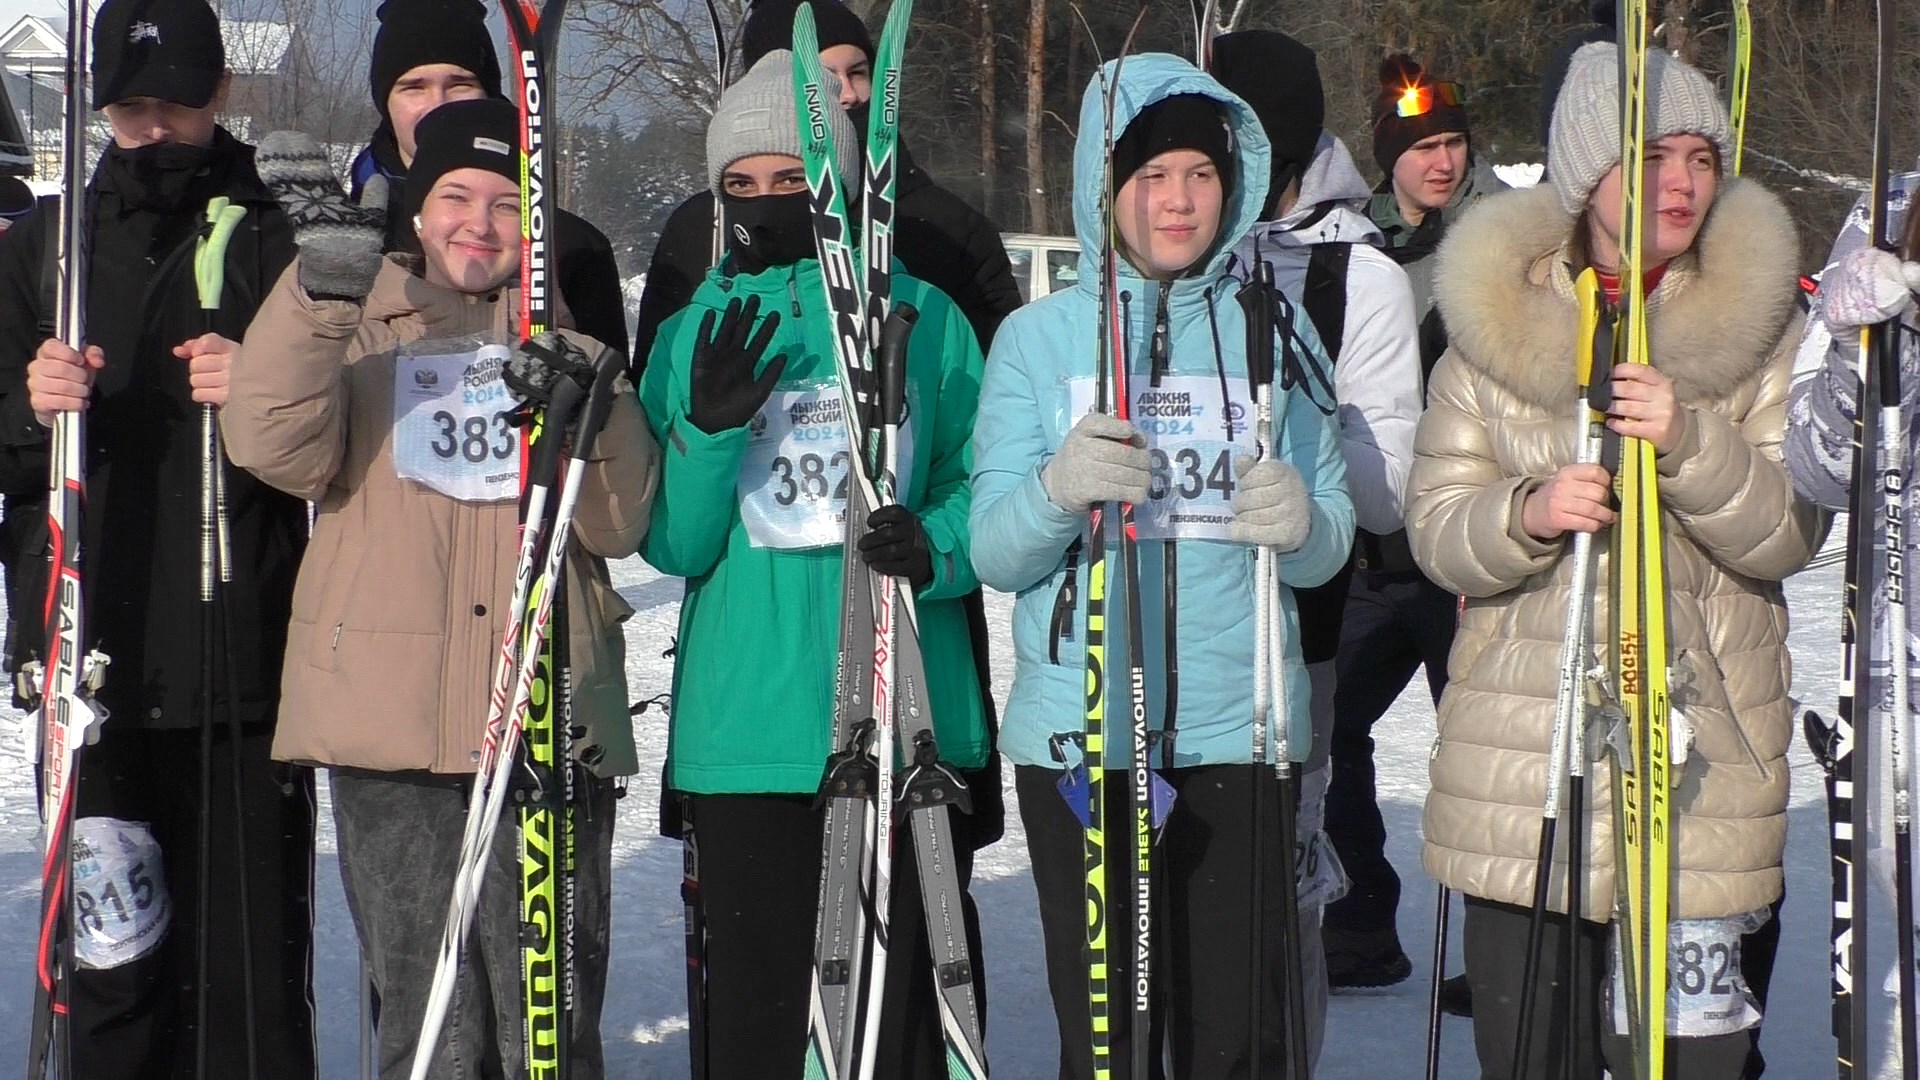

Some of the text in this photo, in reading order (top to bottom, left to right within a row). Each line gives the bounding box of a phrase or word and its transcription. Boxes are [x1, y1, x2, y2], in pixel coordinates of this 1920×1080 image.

[804, 84, 826, 140] OMNI
[884, 69, 898, 125] OMNI
[789, 398, 841, 414] ЛЫЖНЯ
[791, 410, 843, 425] РОССИИ
[1136, 391, 1191, 405] ЛЫЖНЯ
[1138, 405, 1192, 418] РОССИИ
[431, 410, 516, 464] 383
[1138, 420, 1195, 436] 2024
[771, 450, 850, 506] 382
[1169, 514, 1222, 525] ПЕНЗЕНСКАЯ
[57, 578, 75, 728] SABLE
[50, 724, 65, 806] SPORT
[1652, 689, 1666, 845] SABLE
[878, 772, 890, 841] TOURING
[1136, 807, 1149, 873] SABLE
